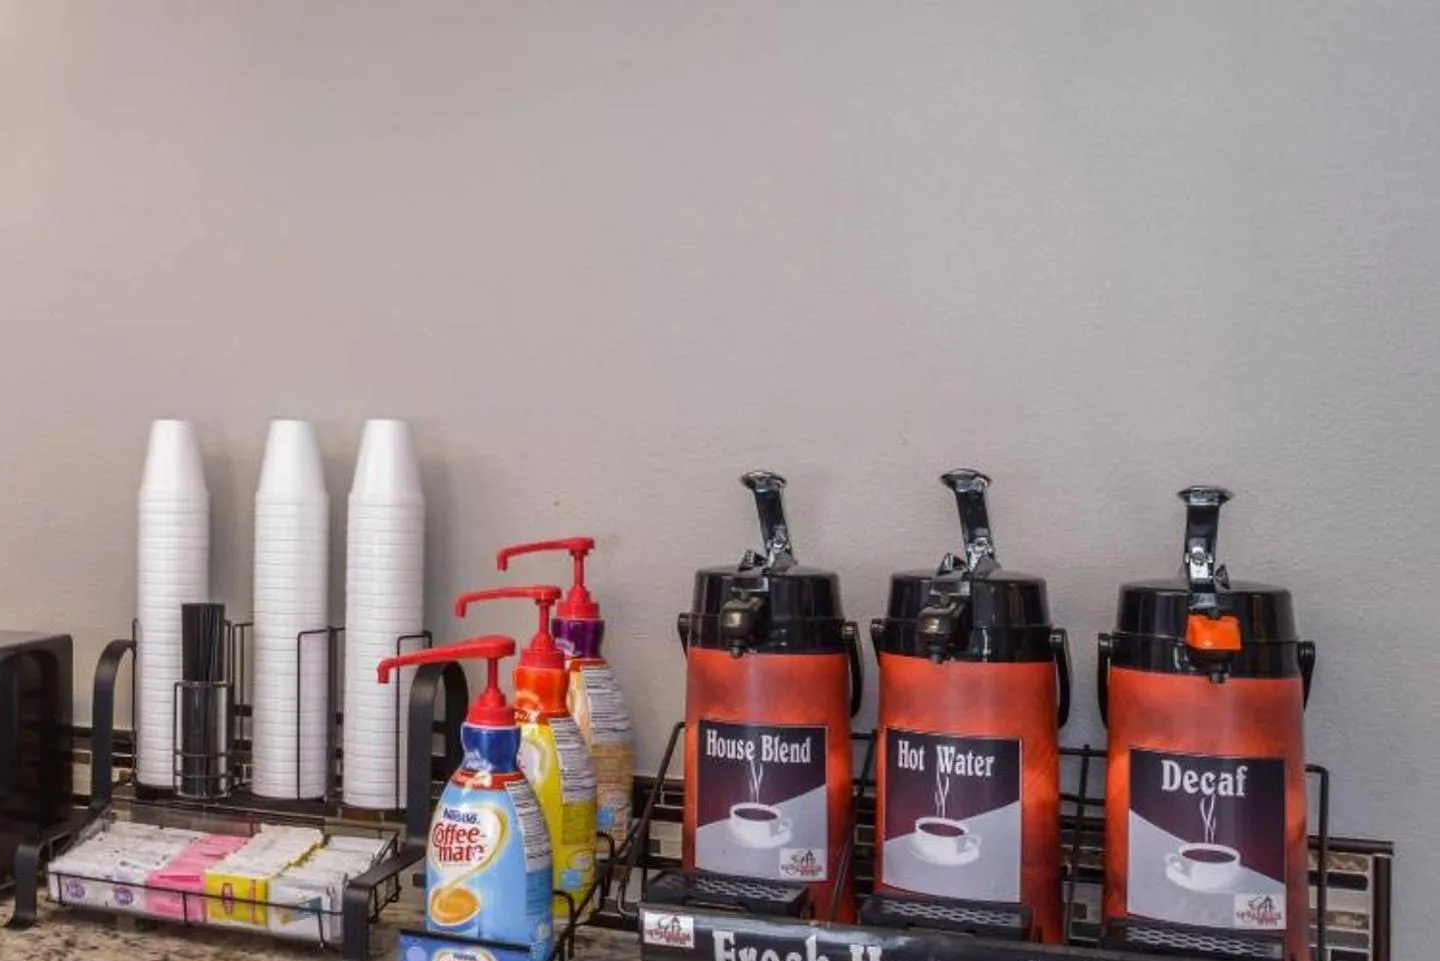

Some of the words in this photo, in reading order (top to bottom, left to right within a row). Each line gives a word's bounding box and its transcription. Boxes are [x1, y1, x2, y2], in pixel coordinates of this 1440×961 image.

[706, 729, 755, 760] House
[761, 735, 811, 763] Blend
[898, 740, 925, 771] Hot
[936, 744, 995, 777] Water
[1161, 760, 1248, 796] Decaf
